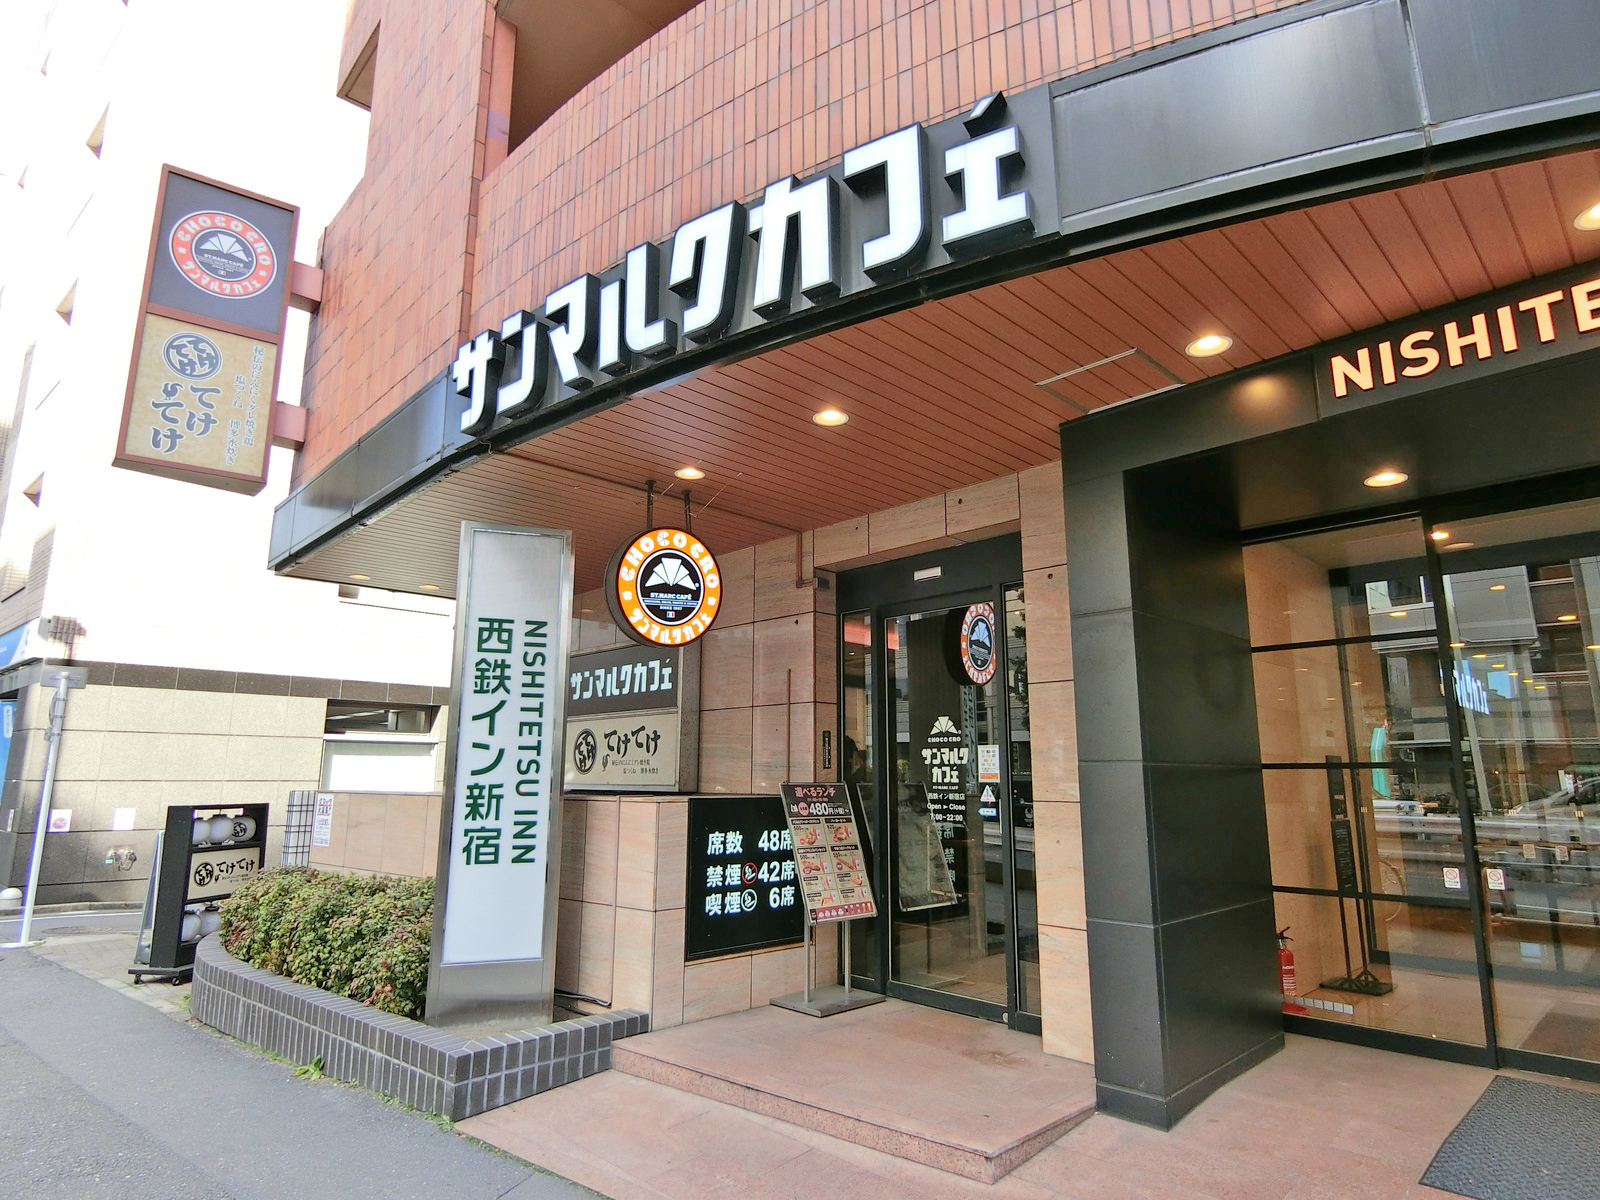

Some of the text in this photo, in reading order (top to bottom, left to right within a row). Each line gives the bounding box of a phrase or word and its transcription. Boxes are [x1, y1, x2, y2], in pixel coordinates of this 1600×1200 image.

[177, 216, 271, 266] CHOCO CRO
[452, 91, 1031, 433] サンマルクカフェ
[620, 530, 720, 589] CHOCO CRO
[629, 608, 713, 644] サンマルクカフェ
[570, 658, 673, 700] サンマルクカフェ
[462, 617, 515, 865] 西鉄イン新宿
[511, 620, 548, 864] NISHITETSU INN
[604, 725, 661, 758] てけてけ
[921, 748, 969, 765] サンマルク
[932, 766, 960, 783] カフェ
[949, 803, 966, 811] Close
[707, 829, 794, 855] 席数 48席
[216, 857, 255, 875] てけてけ
[706, 860, 796, 888] 禁煙 42席
[705, 886, 796, 916] 喫煙 6席
